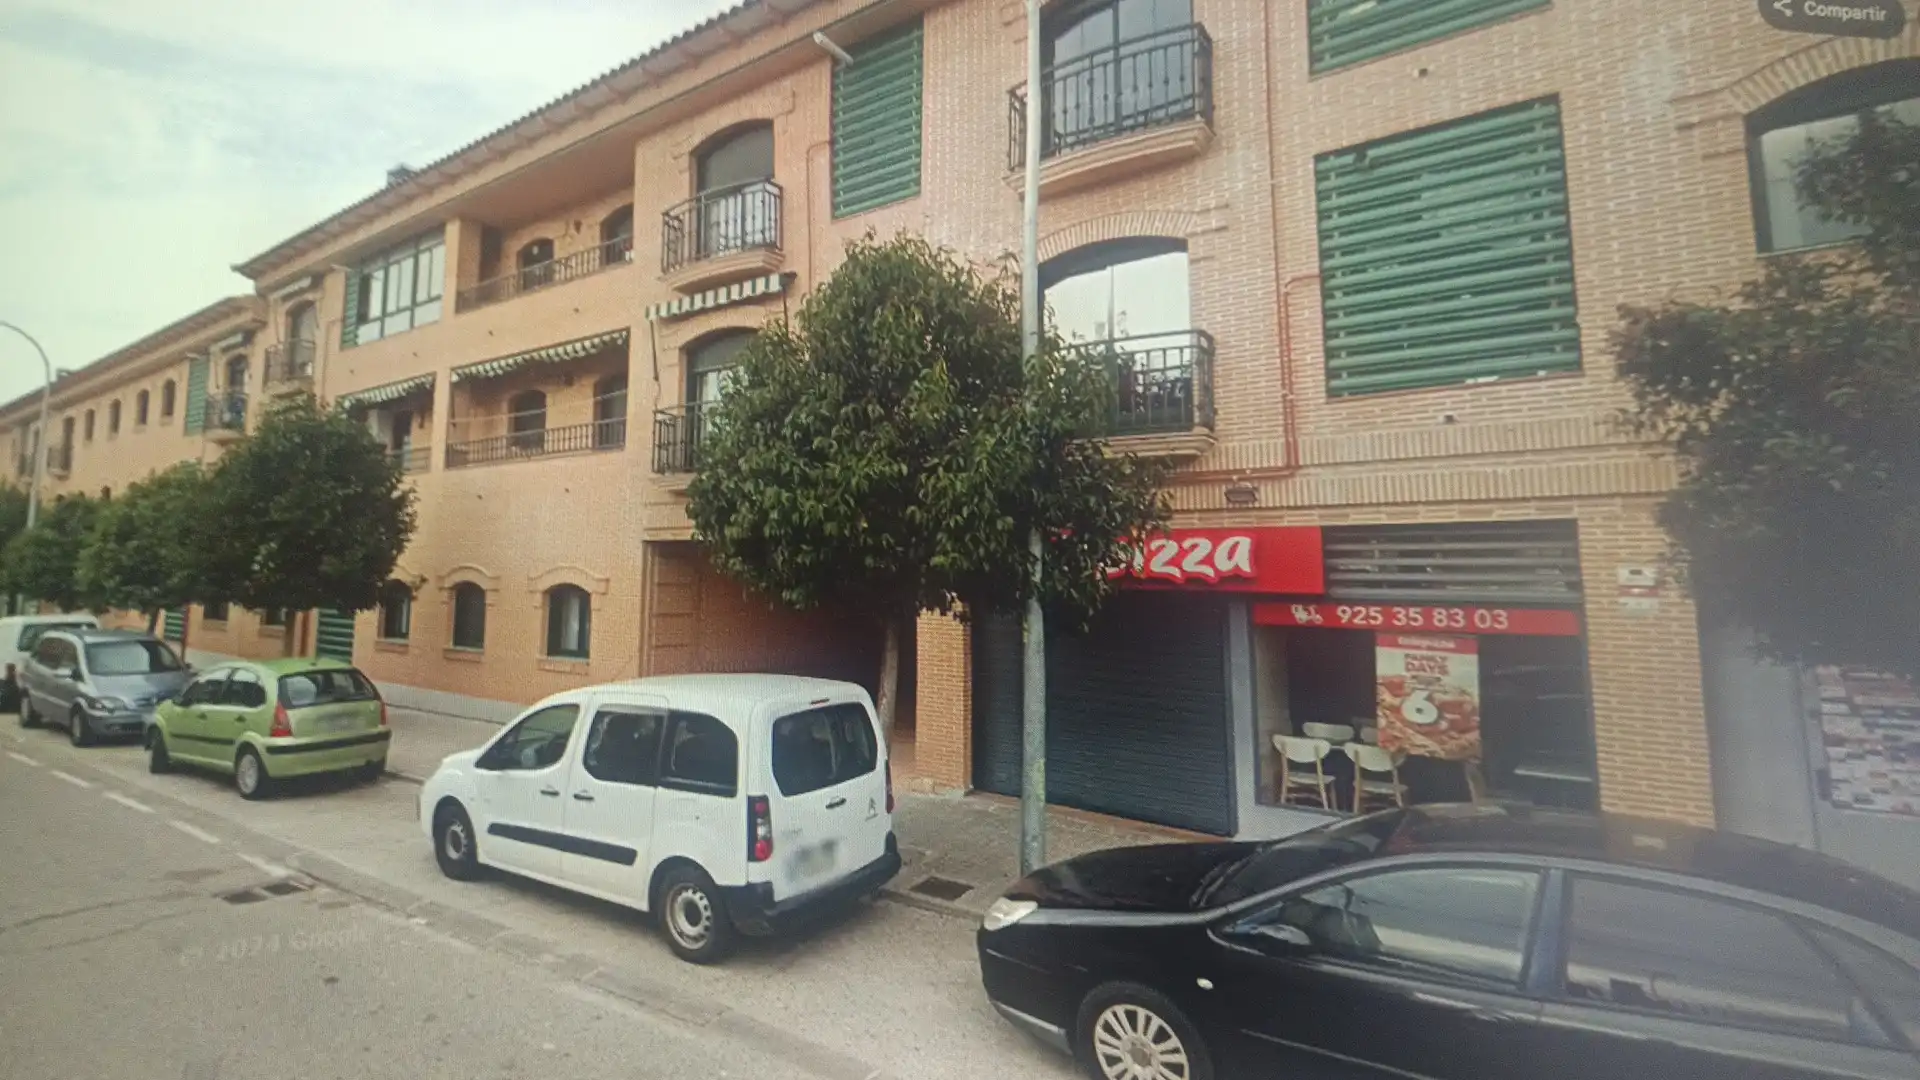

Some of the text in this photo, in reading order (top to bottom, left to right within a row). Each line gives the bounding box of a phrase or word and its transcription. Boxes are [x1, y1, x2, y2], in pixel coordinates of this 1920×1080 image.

[1336, 606, 1509, 629] 925 35 83 03
[1405, 660, 1449, 676] DAYS
[1402, 689, 1438, 724] 6
